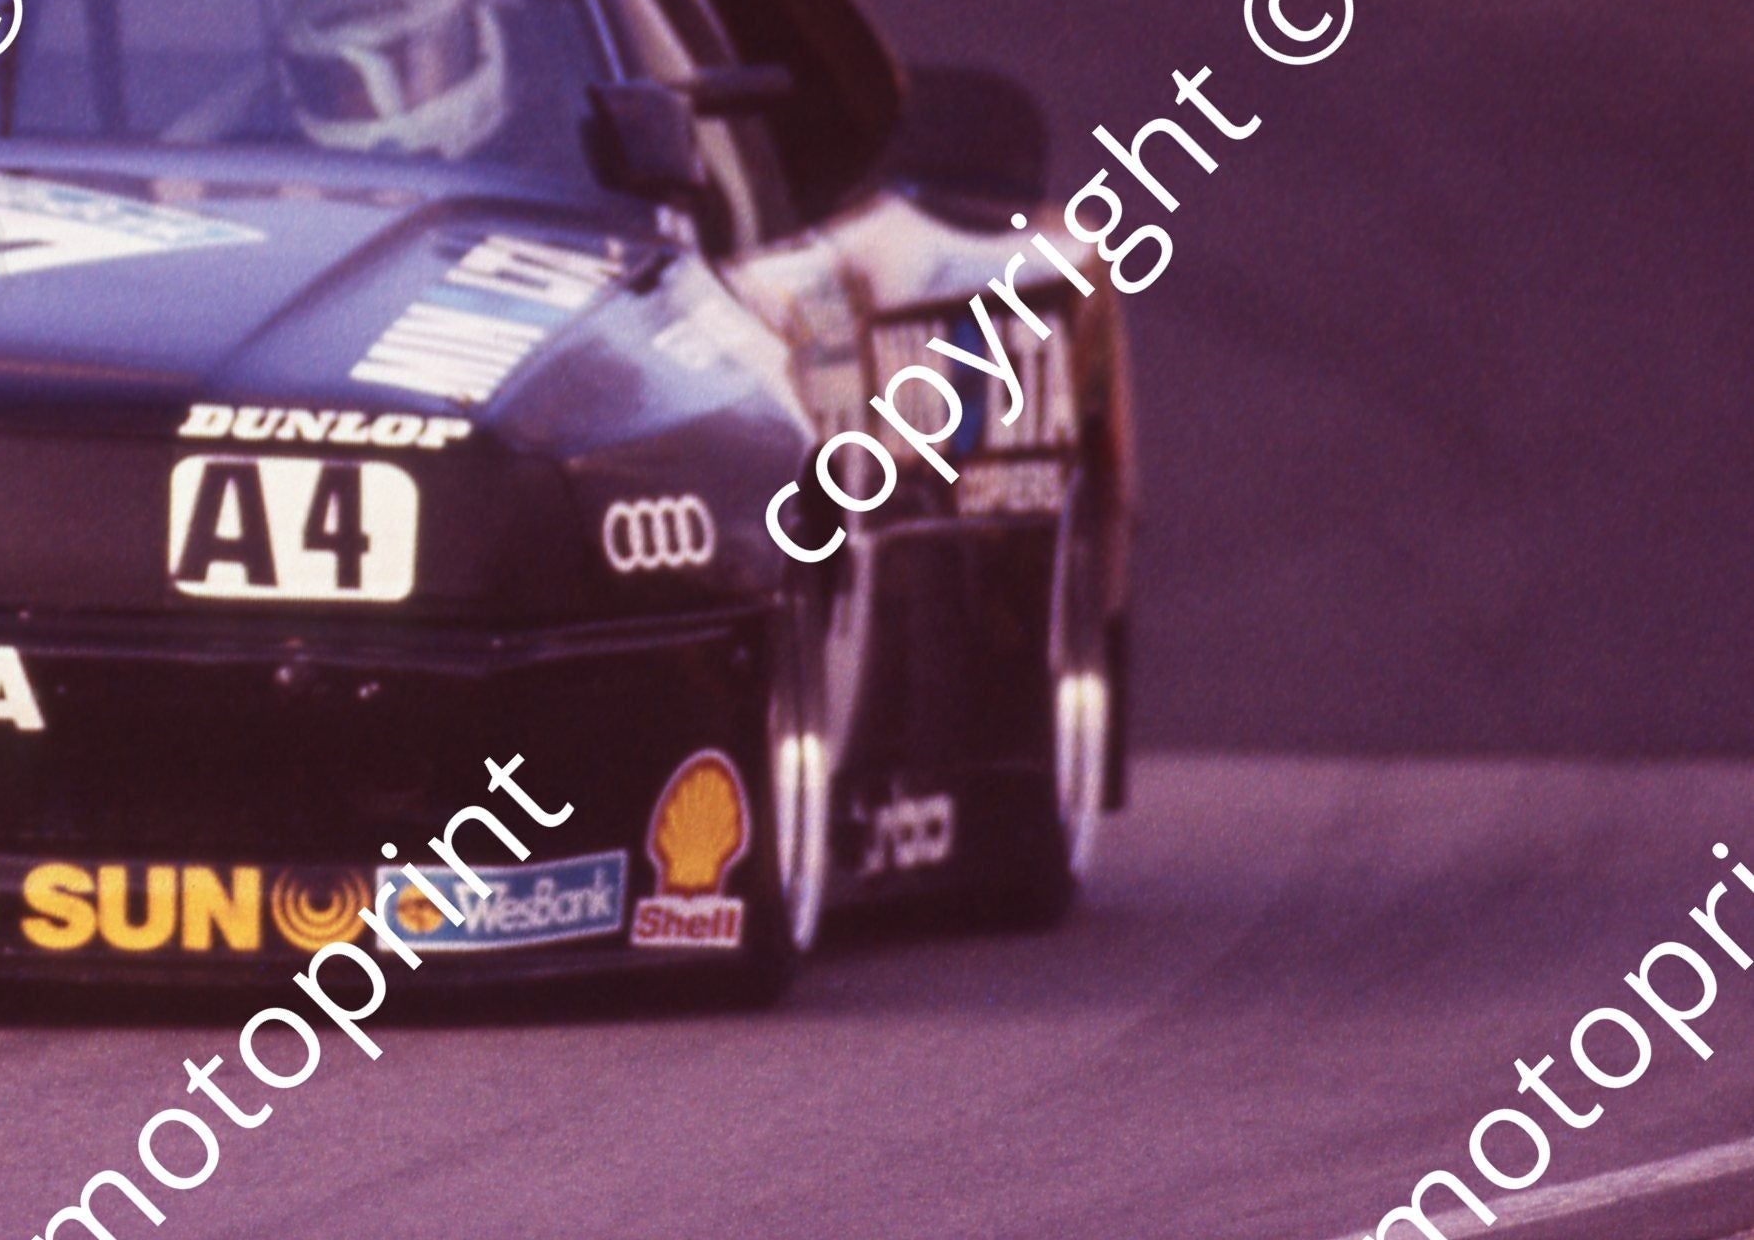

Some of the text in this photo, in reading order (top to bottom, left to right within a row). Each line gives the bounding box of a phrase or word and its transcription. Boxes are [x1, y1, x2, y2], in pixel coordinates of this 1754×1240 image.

[177, 403, 473, 448] DUNLOP
[174, 460, 372, 590] A4
[21, 862, 262, 952] SUN
[453, 866, 613, 933] WesBank
[637, 902, 736, 941] Shell
